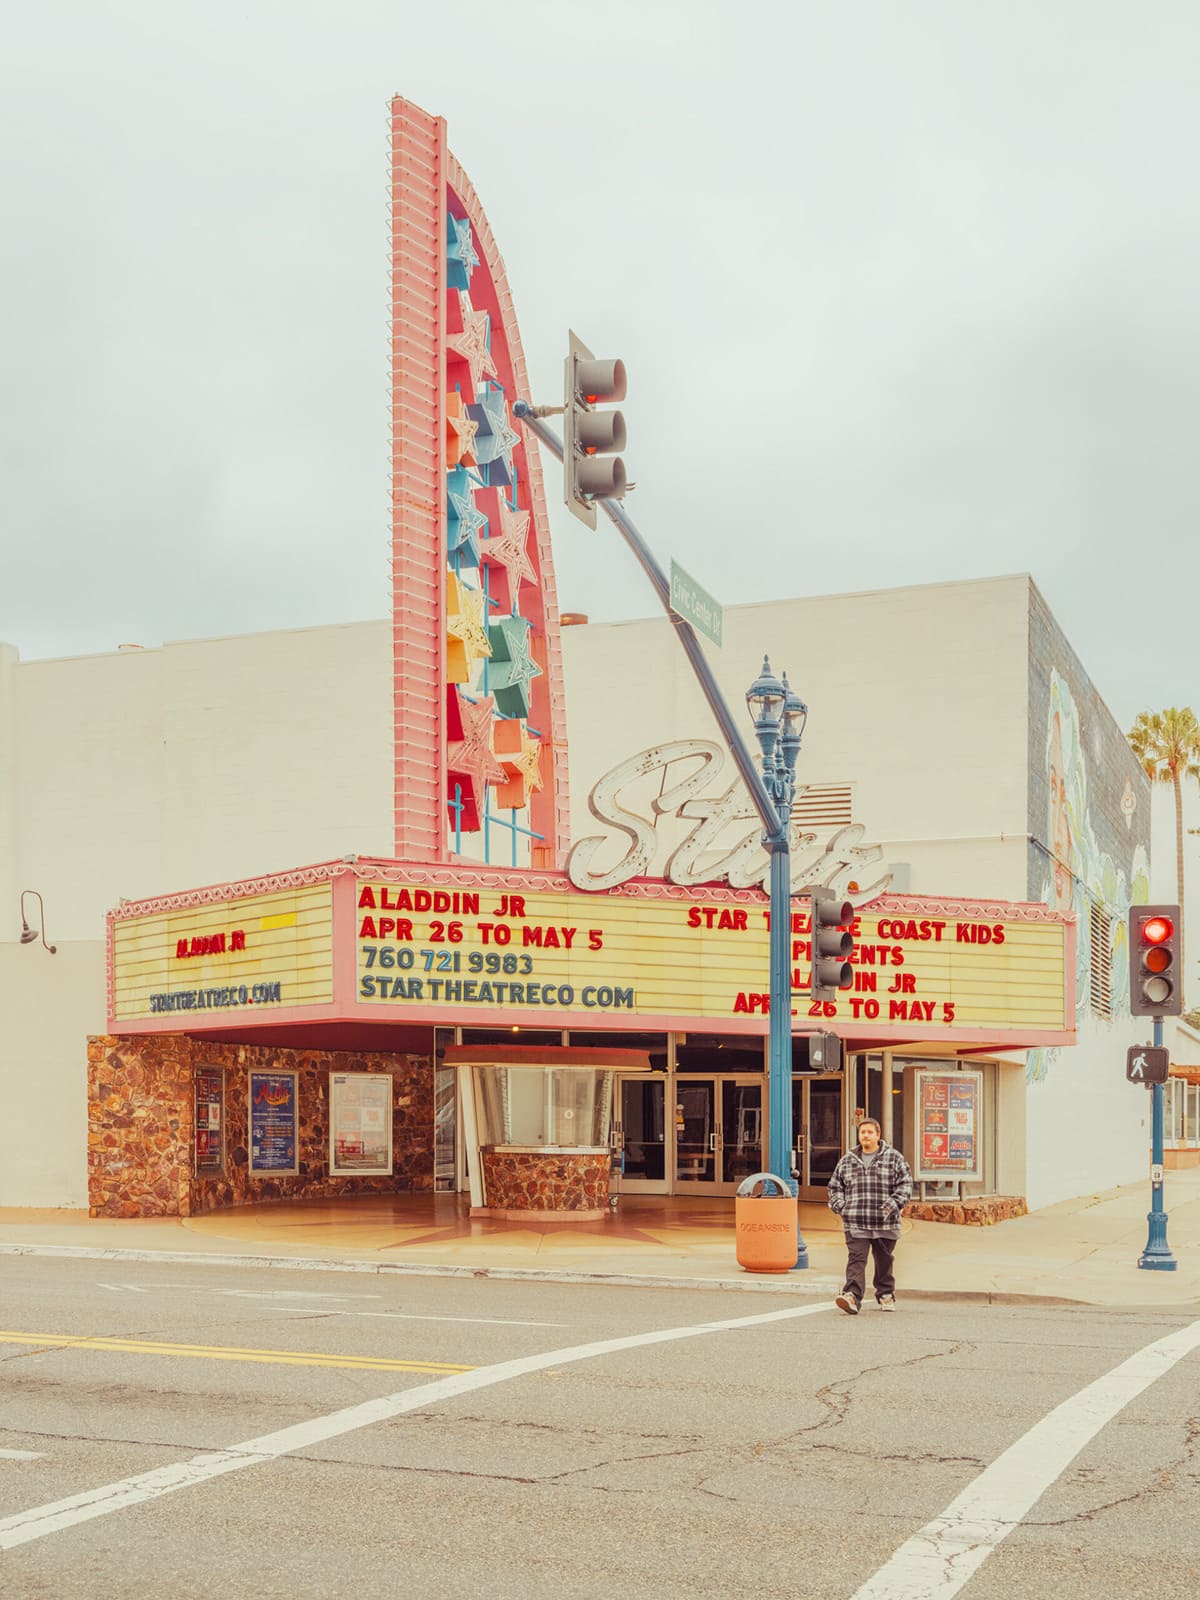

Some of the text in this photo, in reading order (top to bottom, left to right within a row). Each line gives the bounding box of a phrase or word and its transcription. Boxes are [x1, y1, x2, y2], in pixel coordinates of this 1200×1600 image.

[565, 739, 893, 908] Star
[358, 886, 526, 918] ALADDIN JR
[359, 916, 603, 951] APR 26 TO MAY 5
[687, 906, 748, 931] STAR
[877, 919, 946, 942] COAST
[956, 923, 1005, 945] KIDS
[363, 945, 533, 975] 760 721 9983
[582, 985, 634, 1009] COM
[888, 973, 917, 993] JR
[808, 1001, 837, 1018] 26
[849, 998, 880, 1019] TO
[889, 999, 936, 1021] MAY
[943, 1002, 955, 1022] 5
